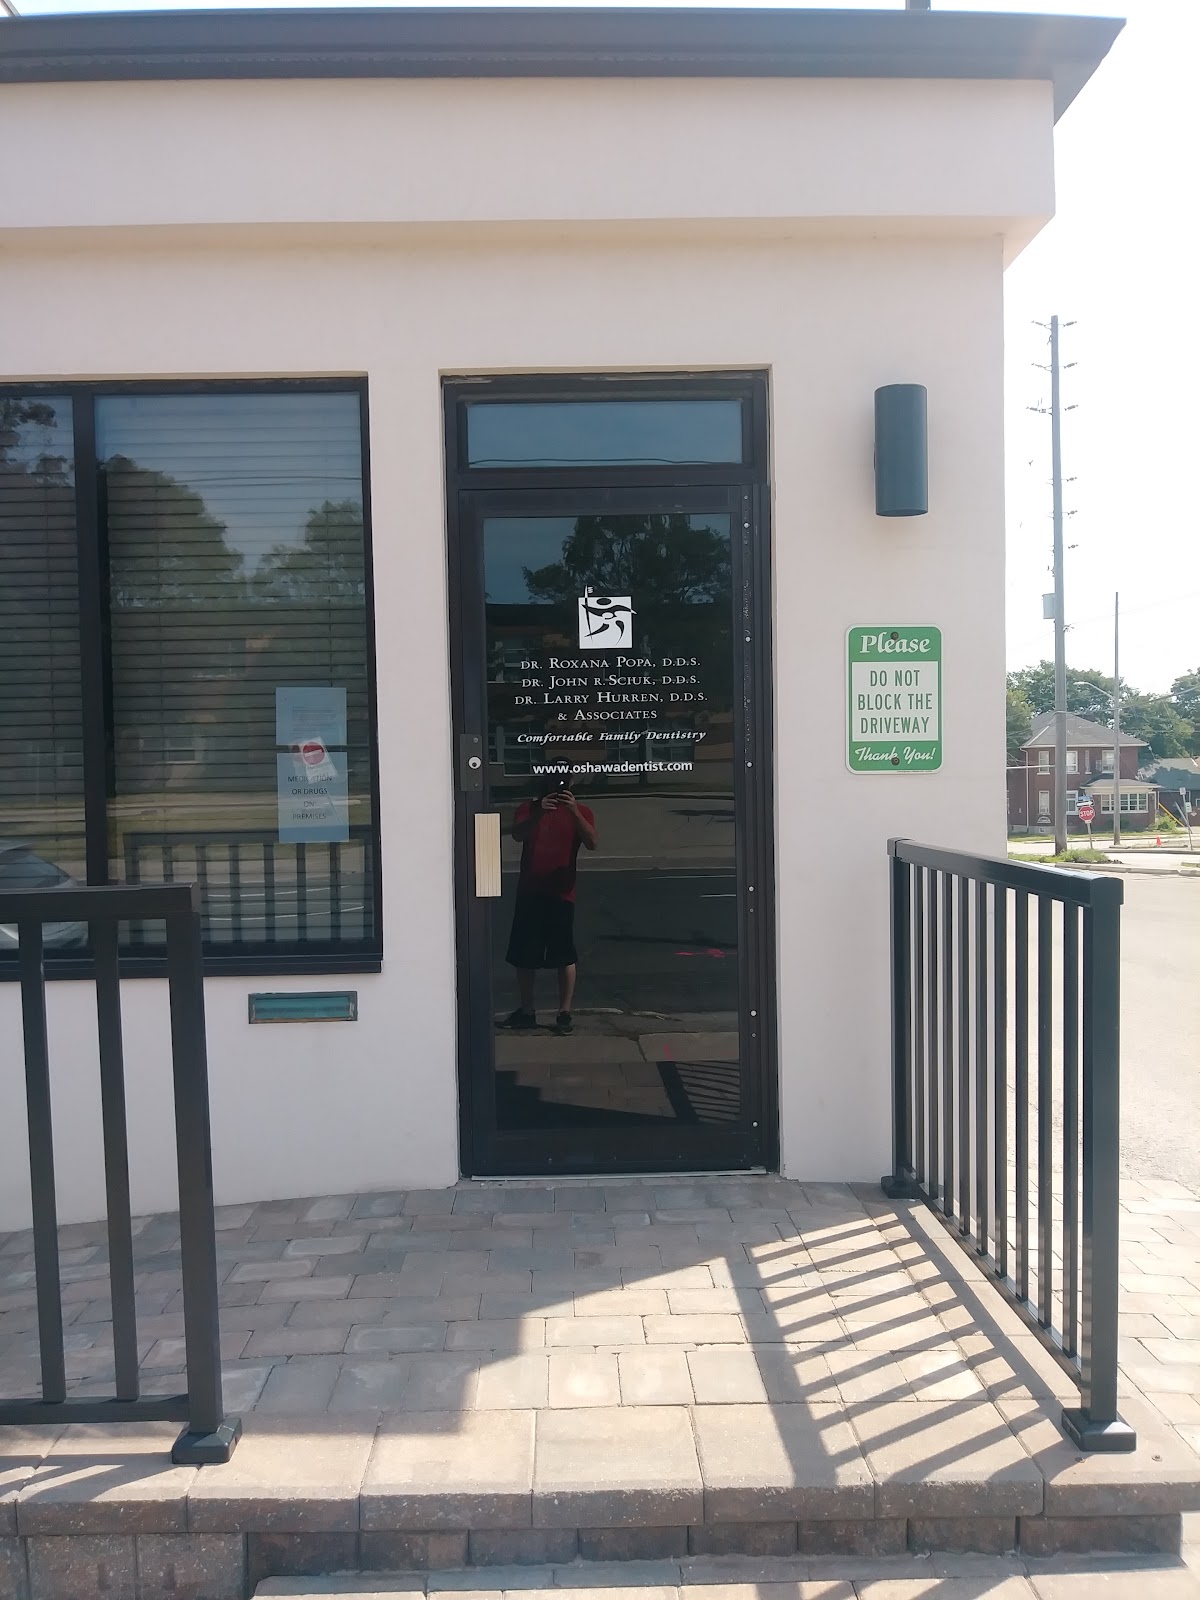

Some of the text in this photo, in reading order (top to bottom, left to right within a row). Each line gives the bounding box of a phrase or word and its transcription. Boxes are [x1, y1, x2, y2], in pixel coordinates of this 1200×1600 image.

[859, 632, 932, 654] Please
[521, 656, 700, 670] DR. ROXANA POPA, D.D.S.
[522, 674, 700, 689] DR. JOHN R. SCIUK, D.D.S.
[870, 670, 920, 686] DO NOT
[514, 692, 708, 704] DR. LARRY HURREN, D.D.S.
[858, 693, 932, 710] BLOCK THE
[558, 710, 658, 720] & ASSOCIATES
[860, 717, 930, 734] DRIVEWAY
[517, 730, 706, 745] Comfortable Family Dentistry
[855, 746, 936, 764] Thank You!
[532, 761, 693, 774] www.oshawadentist.com
